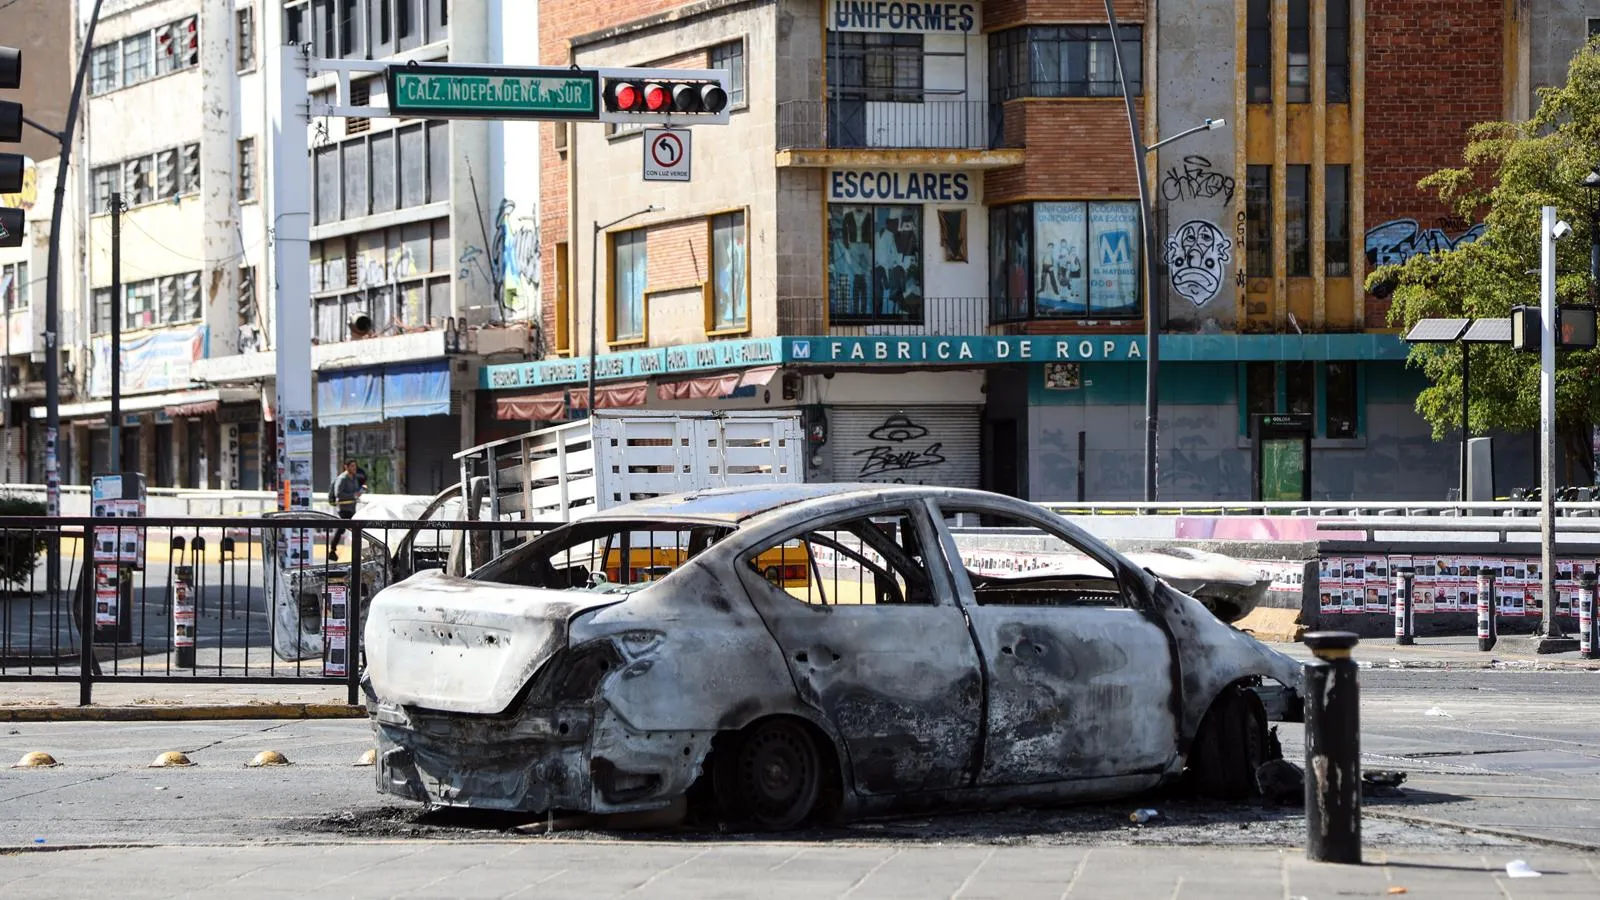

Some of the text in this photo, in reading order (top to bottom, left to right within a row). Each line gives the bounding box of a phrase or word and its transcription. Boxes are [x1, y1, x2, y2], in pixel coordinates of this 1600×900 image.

[836, 1, 974, 32] UNIFORMES
[407, 81, 582, 104] CALZ. INDEPENDENCIA SUR
[832, 170, 969, 201] ESCOLARES
[831, 340, 1141, 359] FABRICA DE ROPA
